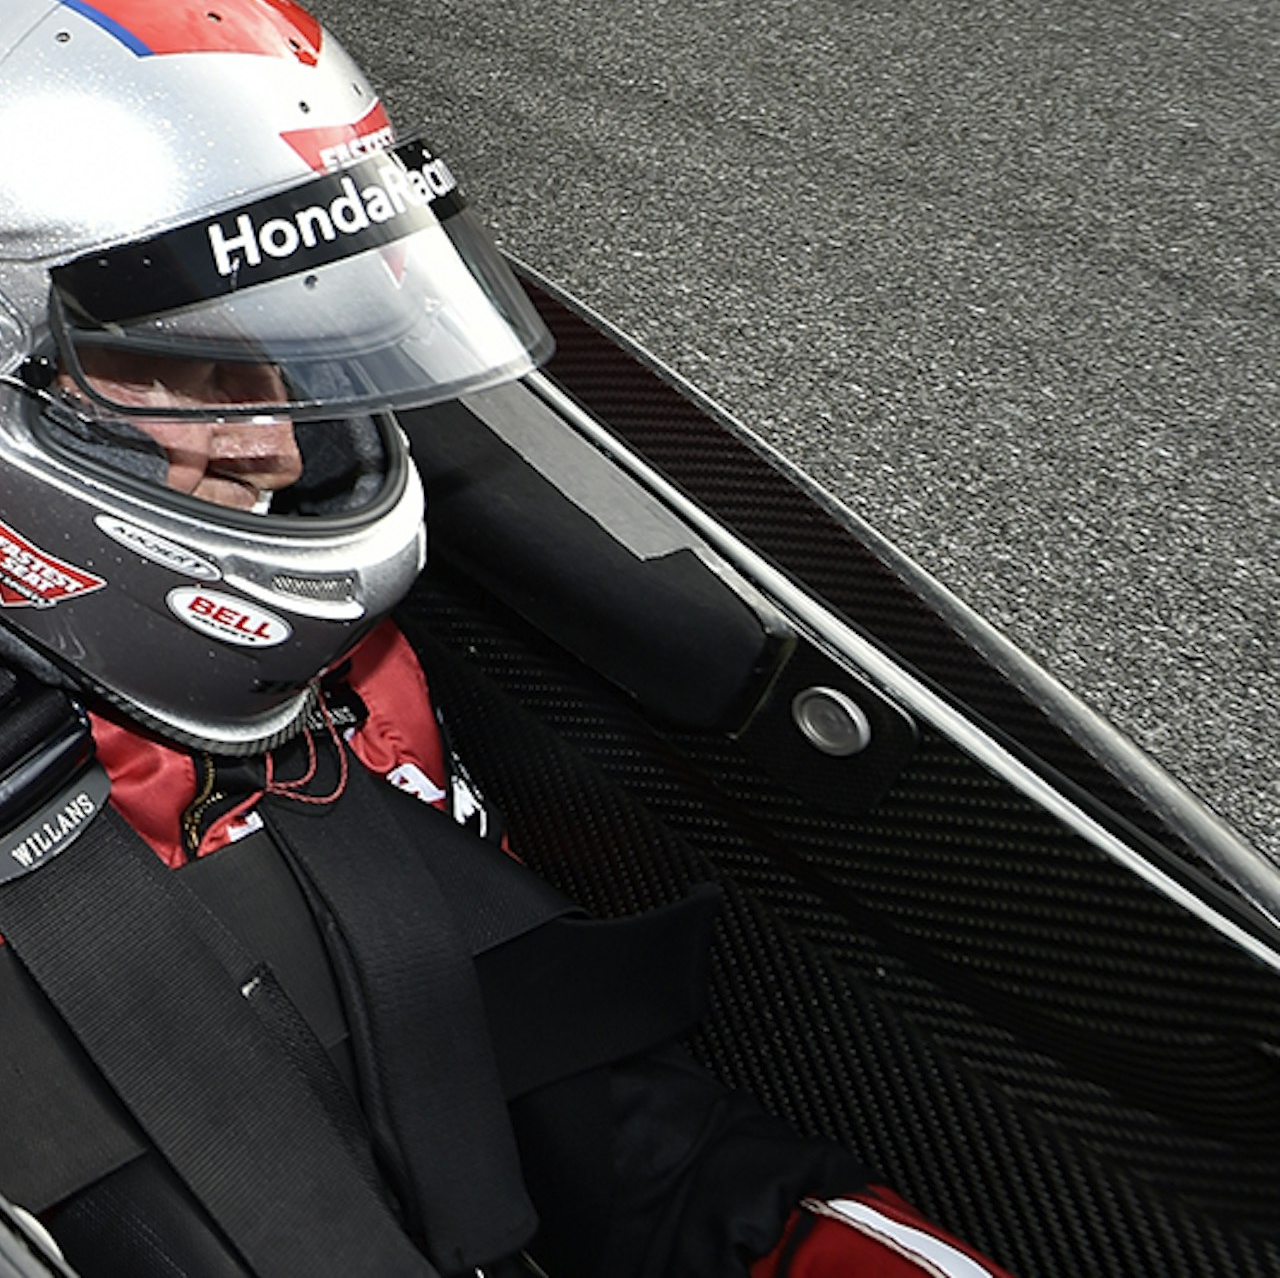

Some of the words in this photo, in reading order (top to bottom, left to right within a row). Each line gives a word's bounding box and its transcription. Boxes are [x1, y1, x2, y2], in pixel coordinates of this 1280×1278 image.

[0, 557, 55, 593] SEAT
[187, 595, 270, 640] BELL
[11, 792, 96, 867] WILLANS
